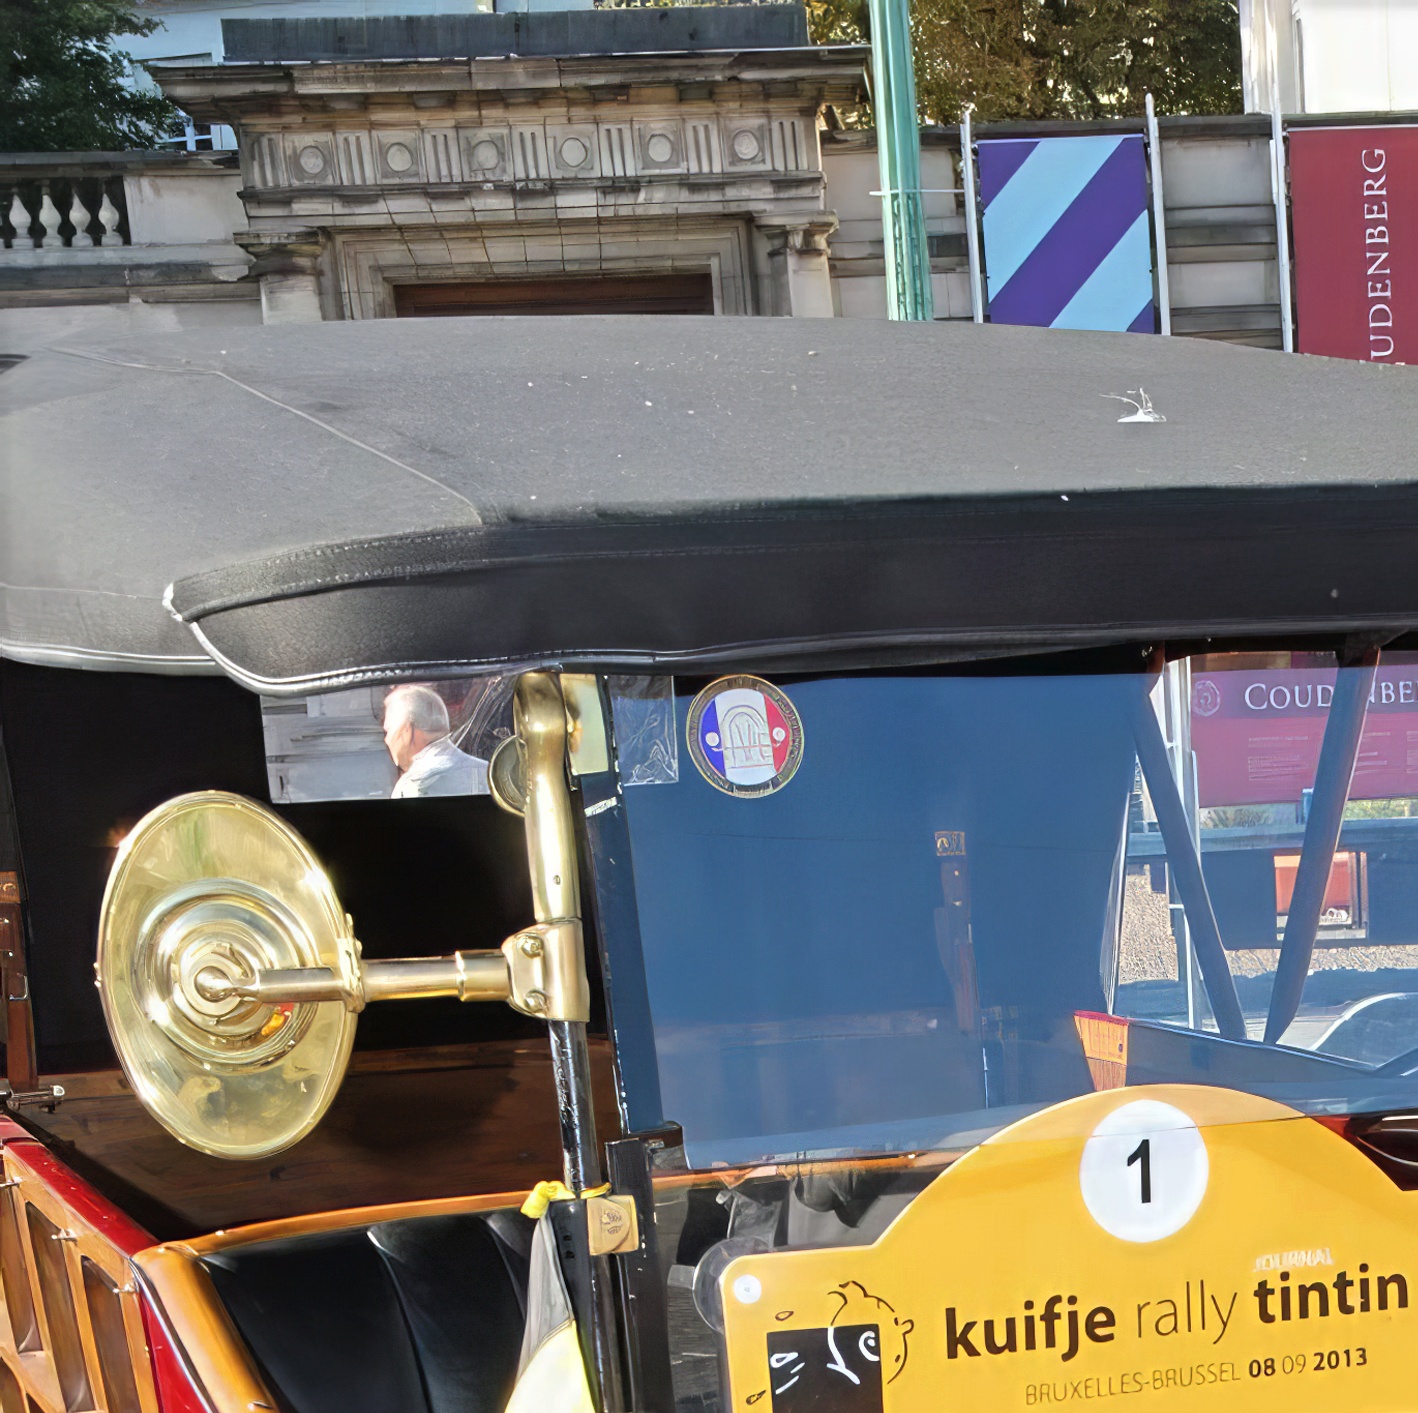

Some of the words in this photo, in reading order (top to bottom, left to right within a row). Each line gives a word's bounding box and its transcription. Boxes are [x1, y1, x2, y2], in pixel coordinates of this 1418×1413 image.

[1361, 148, 1395, 361] UDENBERG
[1126, 1138, 1151, 1204] 1
[945, 1294, 1116, 1362] kuifje
[1136, 1279, 1238, 1345] rally
[1253, 1263, 1409, 1324] tintin
[1025, 1362, 1241, 1406] BRUXELLES-BRUSSEL
[1248, 1357, 1276, 1379] 08
[1281, 1354, 1307, 1375] 09
[1312, 1347, 1368, 1372] 2013
